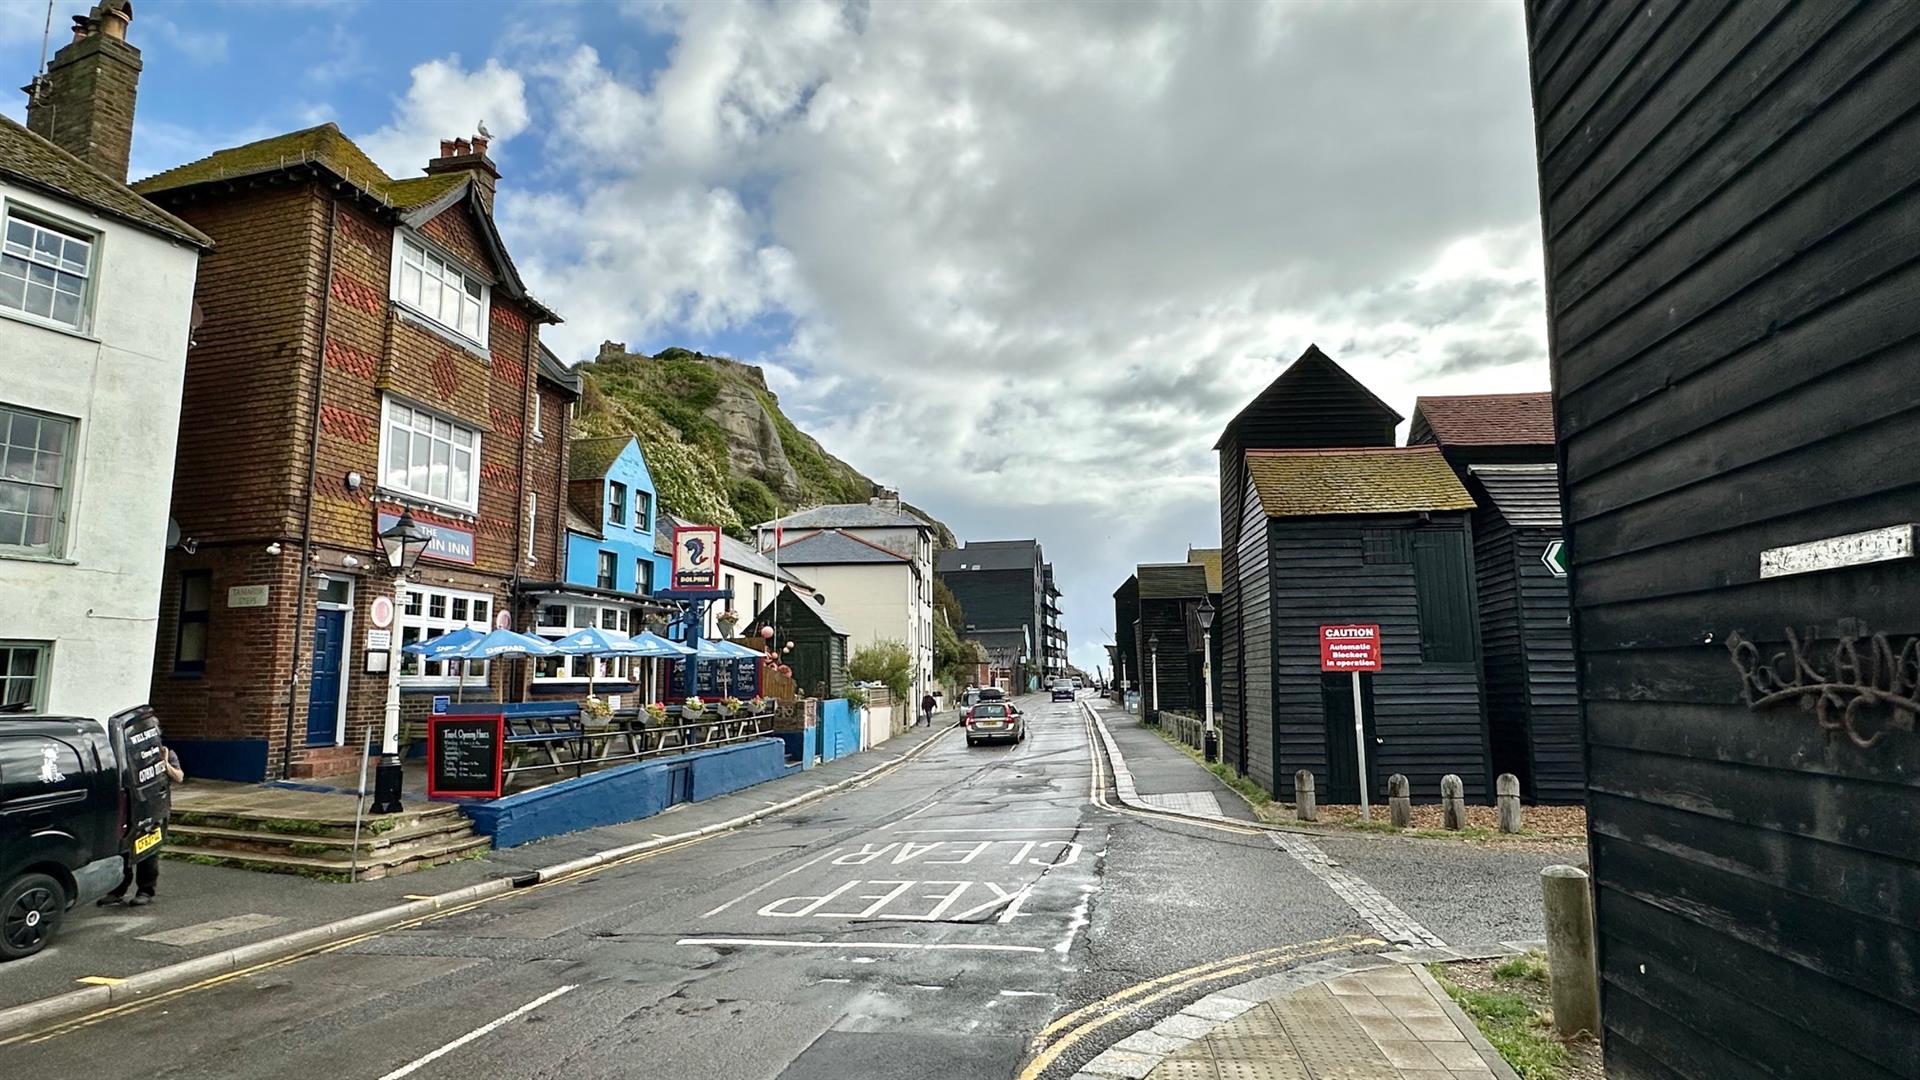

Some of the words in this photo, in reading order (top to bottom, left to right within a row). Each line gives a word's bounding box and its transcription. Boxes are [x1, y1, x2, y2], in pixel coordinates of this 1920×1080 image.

[422, 527, 438, 536] THE
[448, 542, 469, 555] INN
[1326, 629, 1373, 637] CAUTION
[831, 840, 1084, 866] CLEAR
[757, 880, 1032, 923] KEEP
